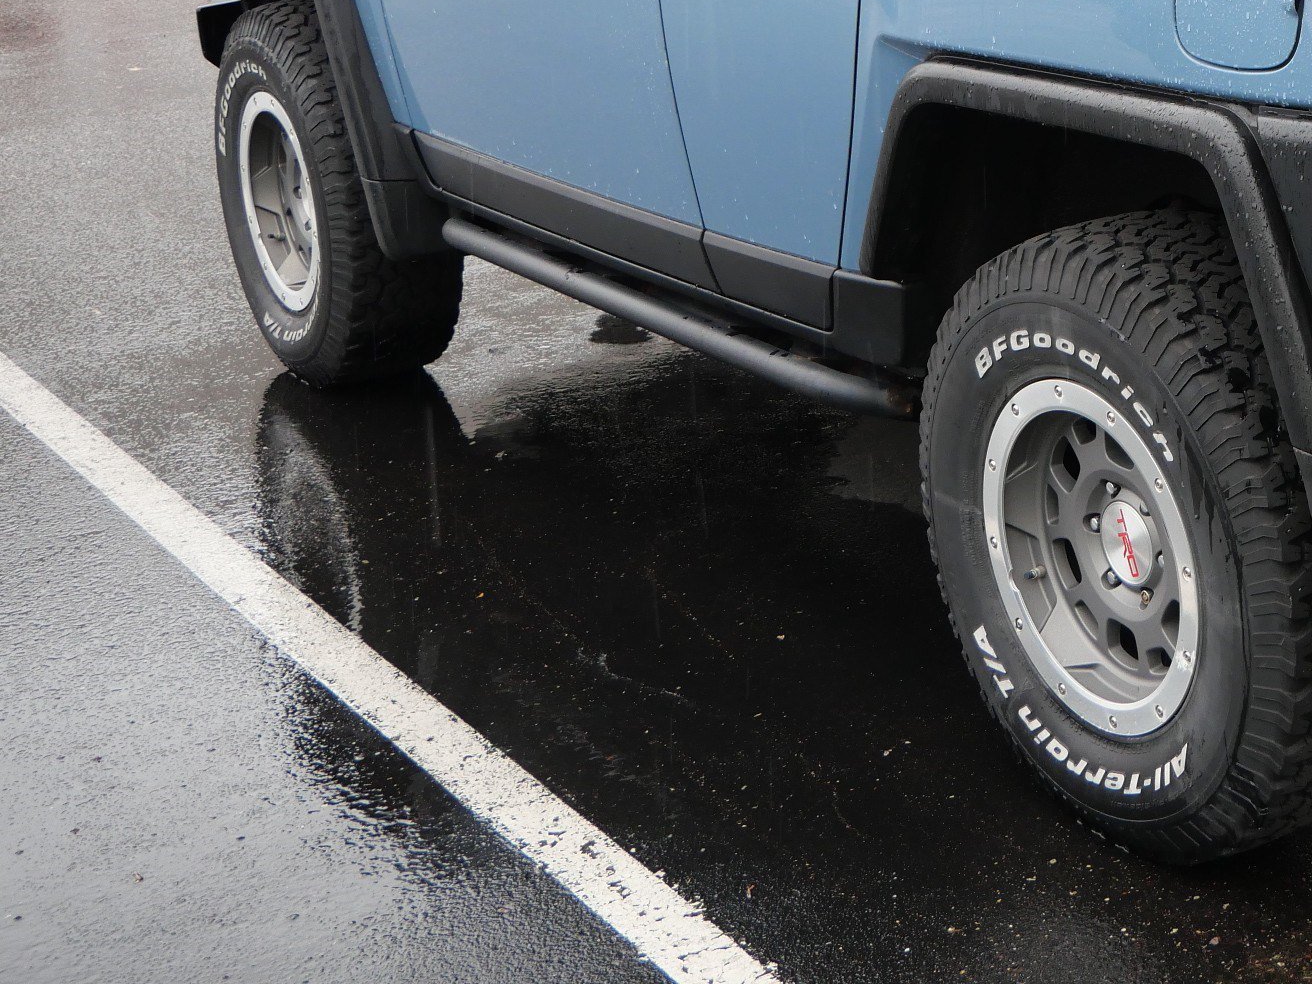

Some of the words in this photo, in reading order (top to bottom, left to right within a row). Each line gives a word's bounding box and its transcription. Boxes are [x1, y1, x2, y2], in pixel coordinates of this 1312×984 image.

[218, 59, 267, 157] BFGoodrich
[975, 329, 1174, 463] BFGoodrich
[1116, 508, 1140, 578] TRD
[972, 624, 1014, 699] T/A
[1018, 704, 1188, 795] All-Terrain
